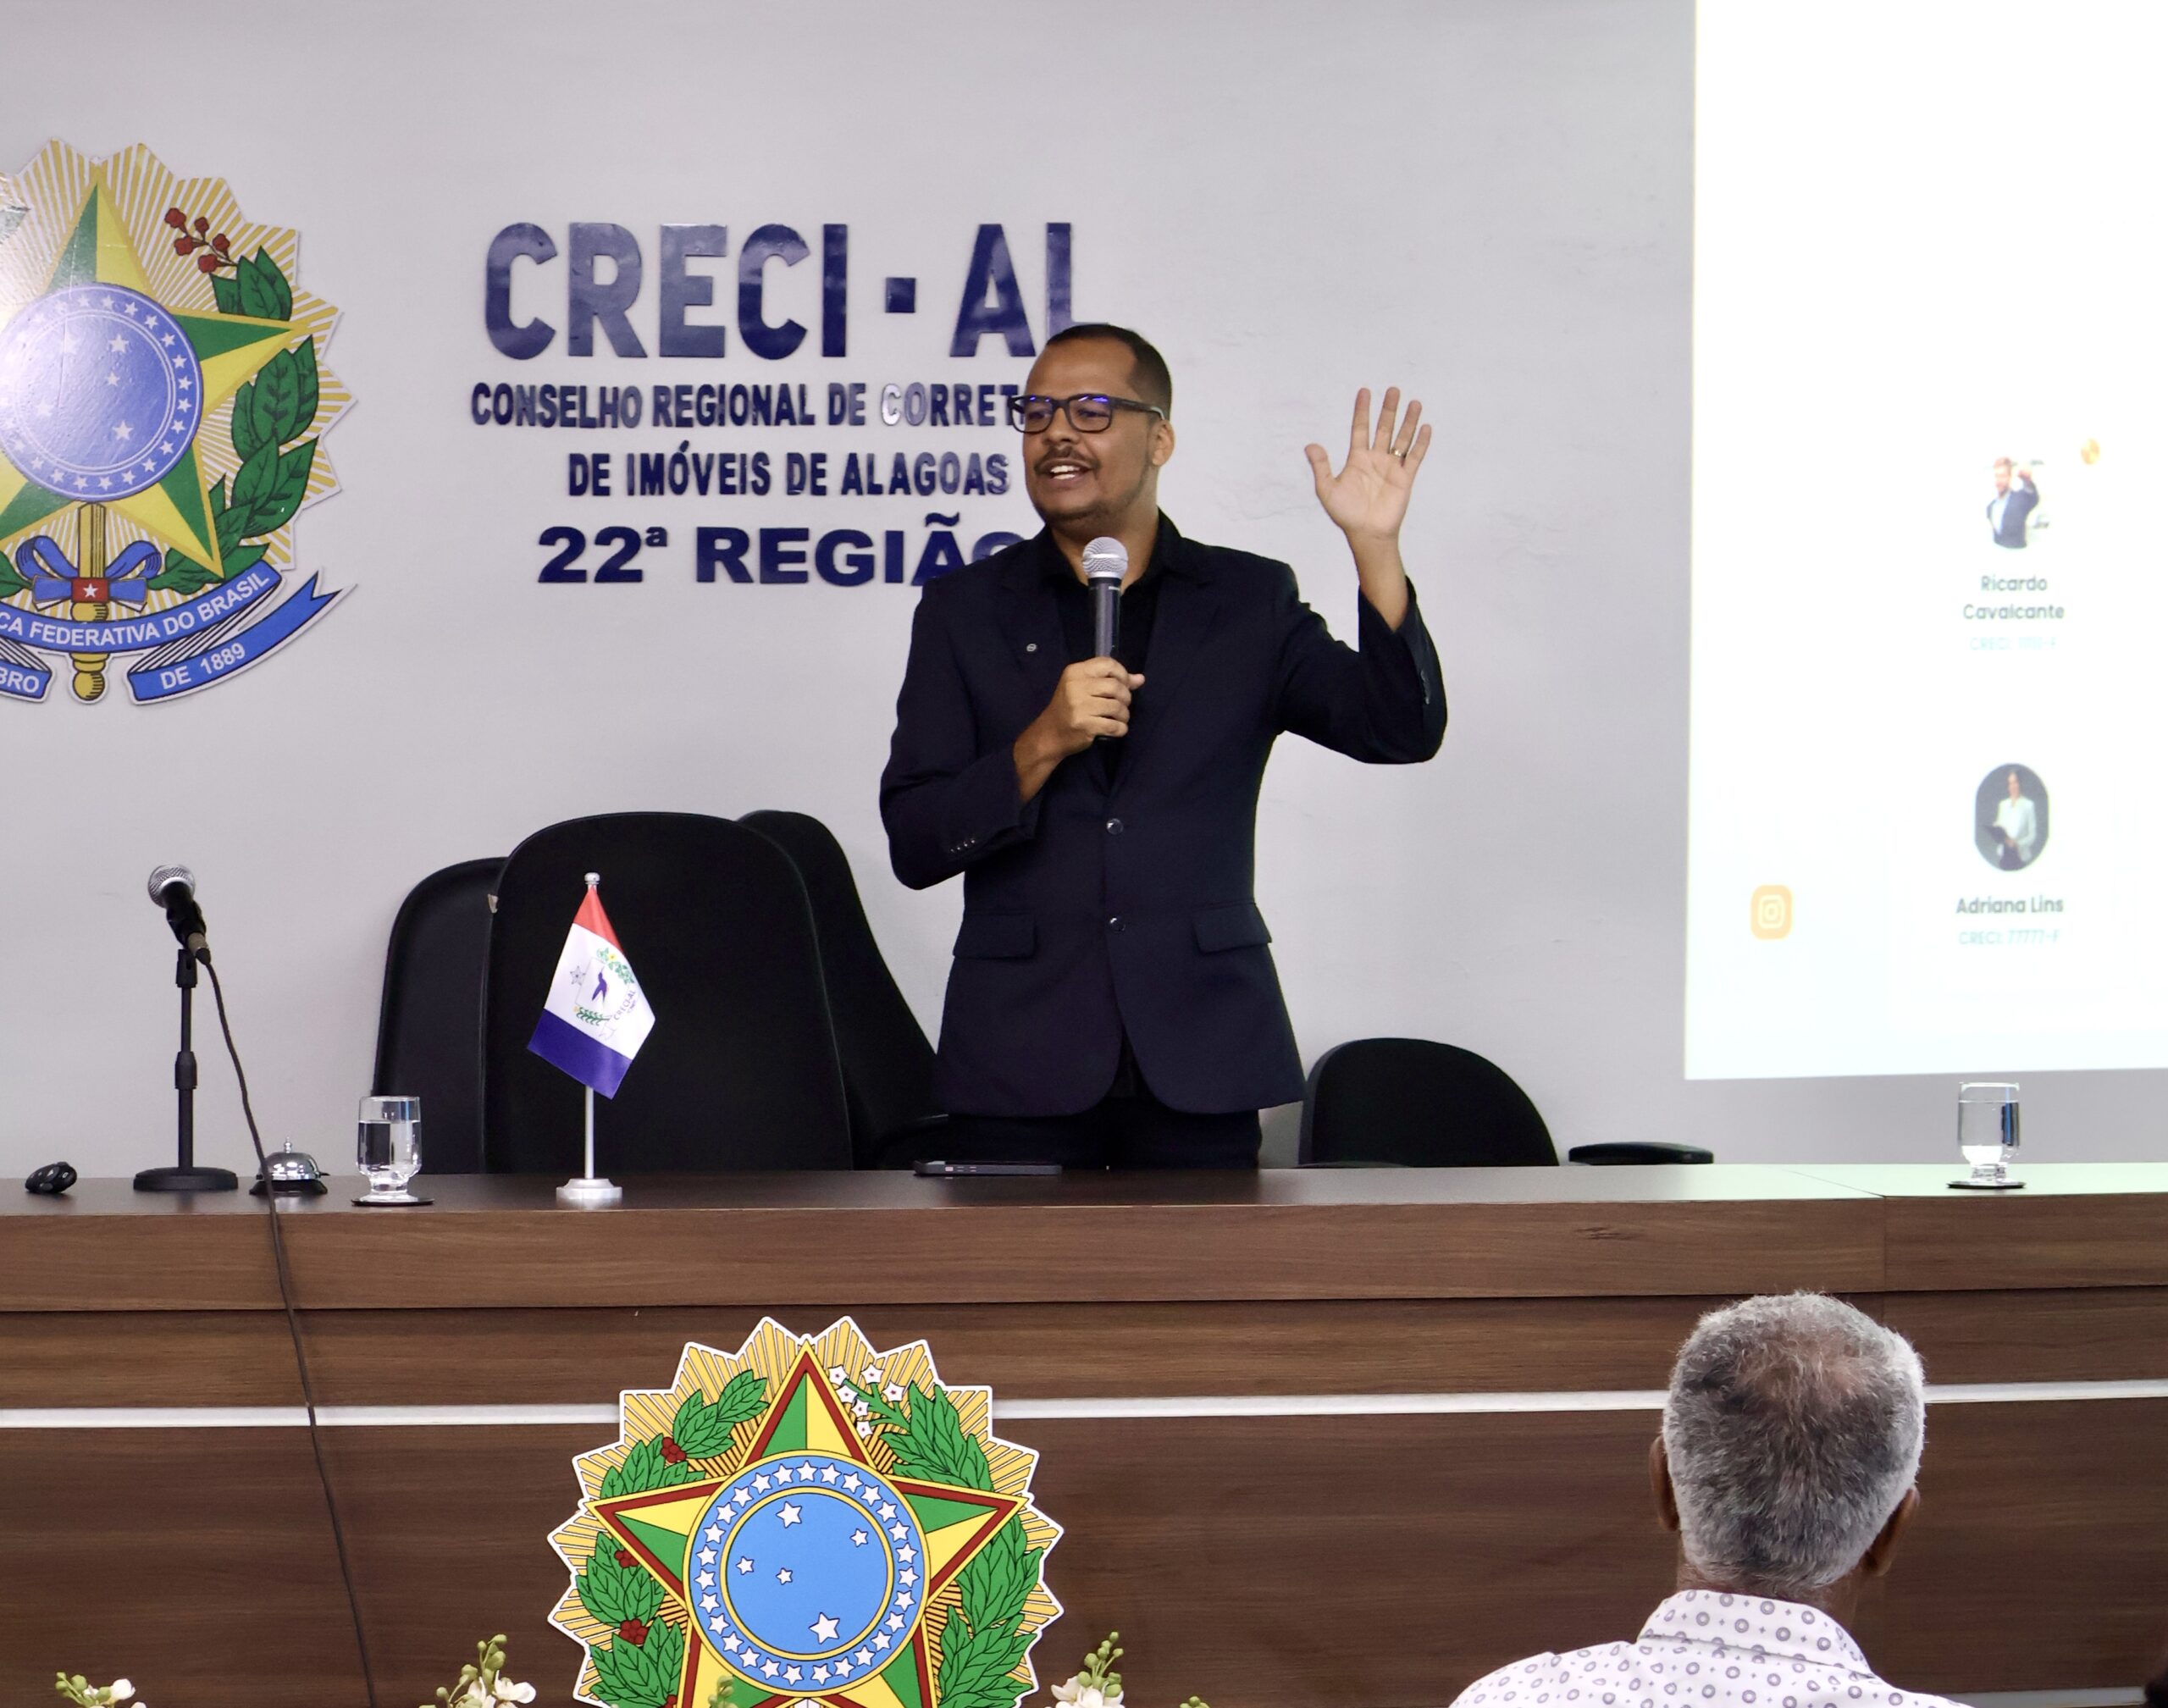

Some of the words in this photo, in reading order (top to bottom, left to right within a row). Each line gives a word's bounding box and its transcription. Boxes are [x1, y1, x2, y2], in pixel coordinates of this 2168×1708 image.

[485, 223, 849, 360] CRECI
[471, 382, 643, 428] CONSELHO
[652, 383, 815, 427] REGIONAL
[828, 384, 866, 427] DE
[881, 383, 1024, 426] CORRET
[569, 453, 610, 496] DE
[627, 441, 771, 496] IMÓVEIS
[787, 453, 827, 495] DE
[840, 453, 1010, 496] ALAGOAS
[1980, 574, 2048, 592] Ricardo
[29, 621, 161, 648] FEDERATIVA
[163, 611, 196, 634] DO
[196, 573, 270, 622] BRASIL
[1963, 604, 2065, 620] Cavalcante
[160, 666, 192, 690] DE
[200, 642, 246, 677] 1889
[1955, 895, 2026, 914] Adriana
[2031, 894, 2065, 913] Lins
